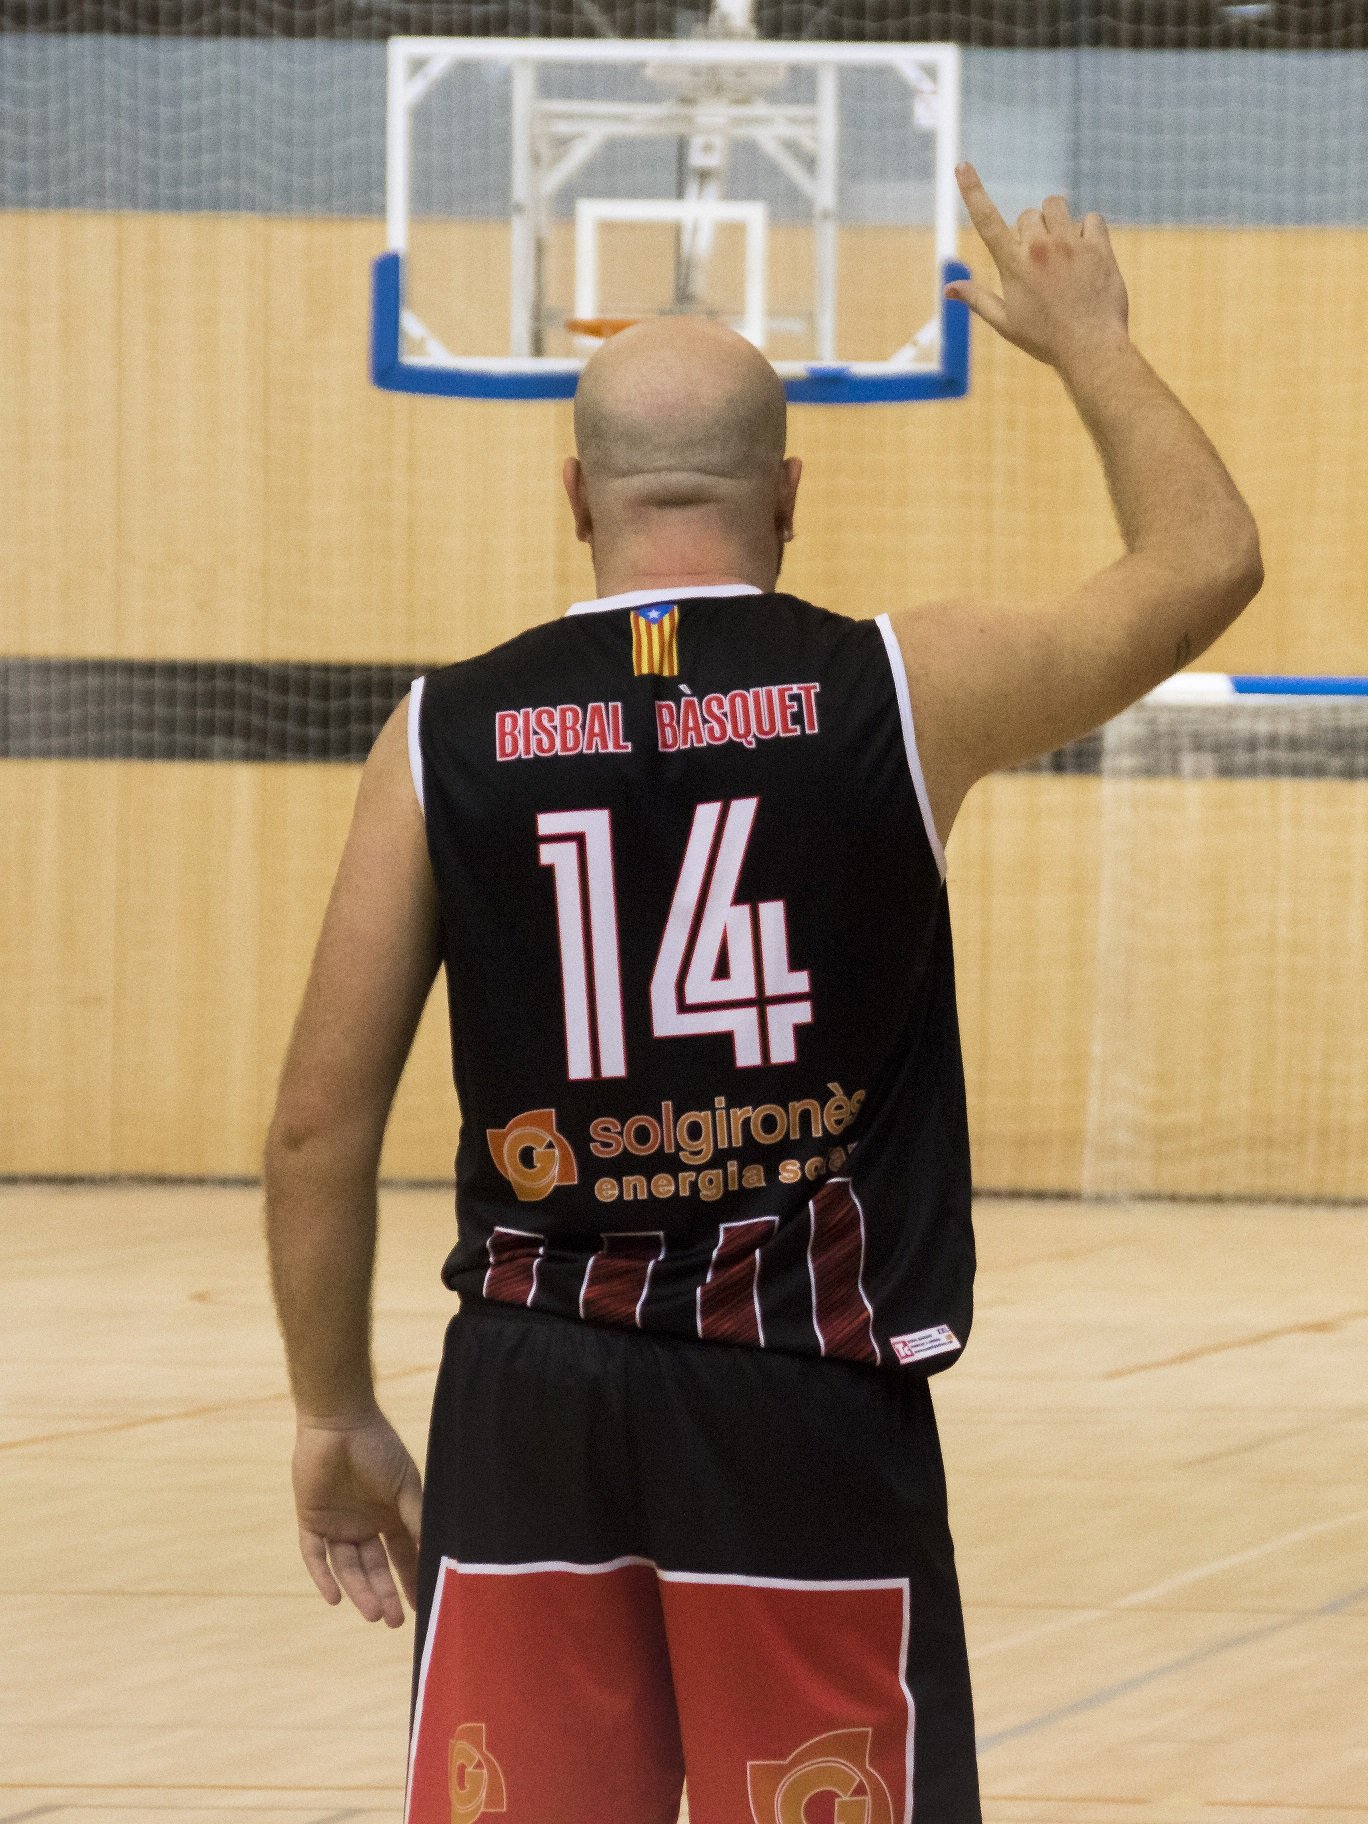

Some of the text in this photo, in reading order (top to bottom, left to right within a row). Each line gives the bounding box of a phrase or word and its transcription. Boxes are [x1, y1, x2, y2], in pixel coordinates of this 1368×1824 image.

[495, 682, 821, 761] BISBAL BÀSQUET
[536, 797, 813, 1080] 14
[594, 1159, 767, 1202] energia
